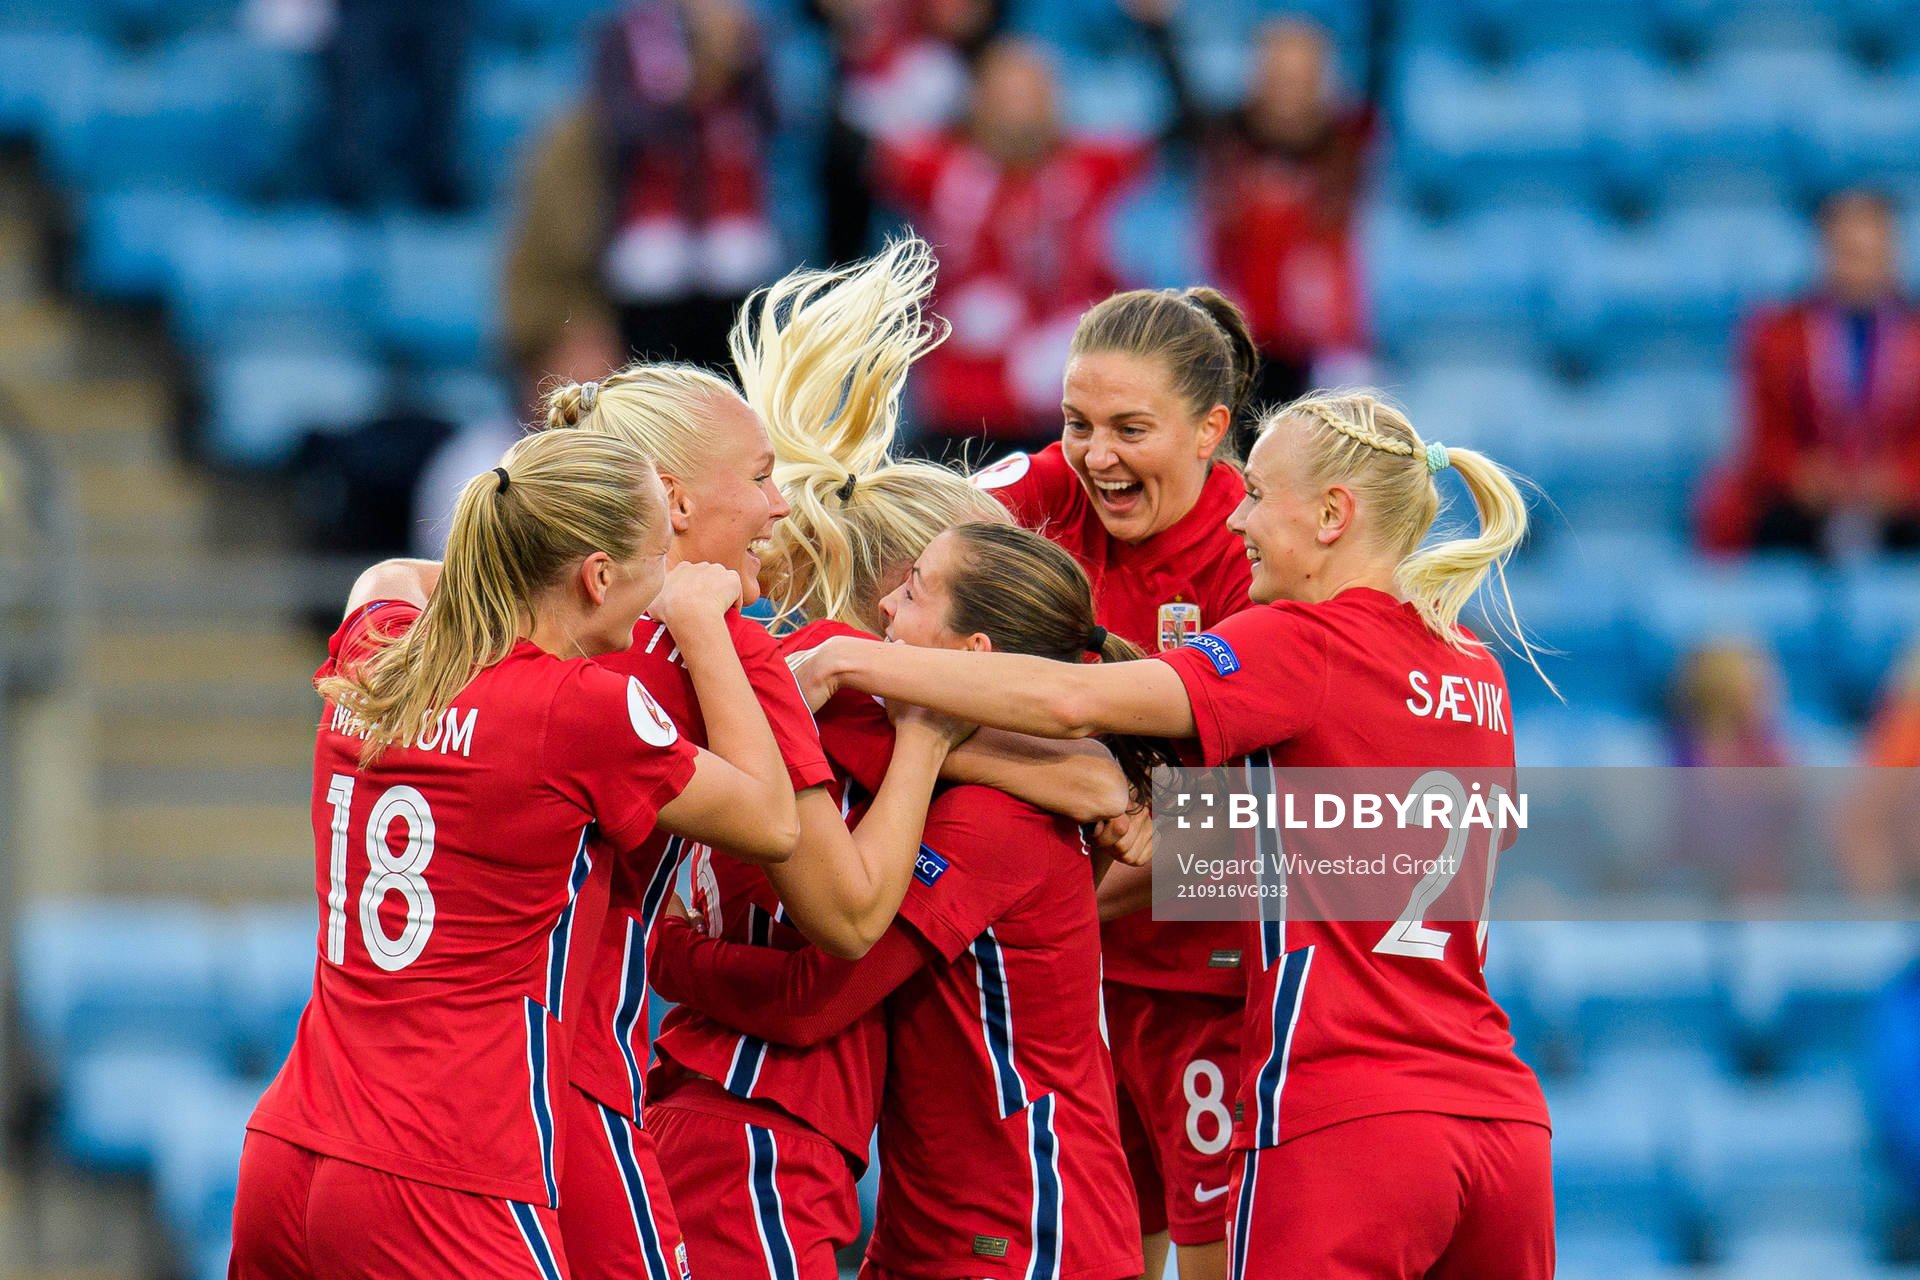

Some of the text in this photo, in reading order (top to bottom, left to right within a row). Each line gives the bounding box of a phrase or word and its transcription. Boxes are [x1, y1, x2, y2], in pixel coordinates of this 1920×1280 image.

[1406, 671, 1508, 735] SÆVIK
[326, 773, 435, 971] 18
[1183, 1059, 1233, 1155] 8
